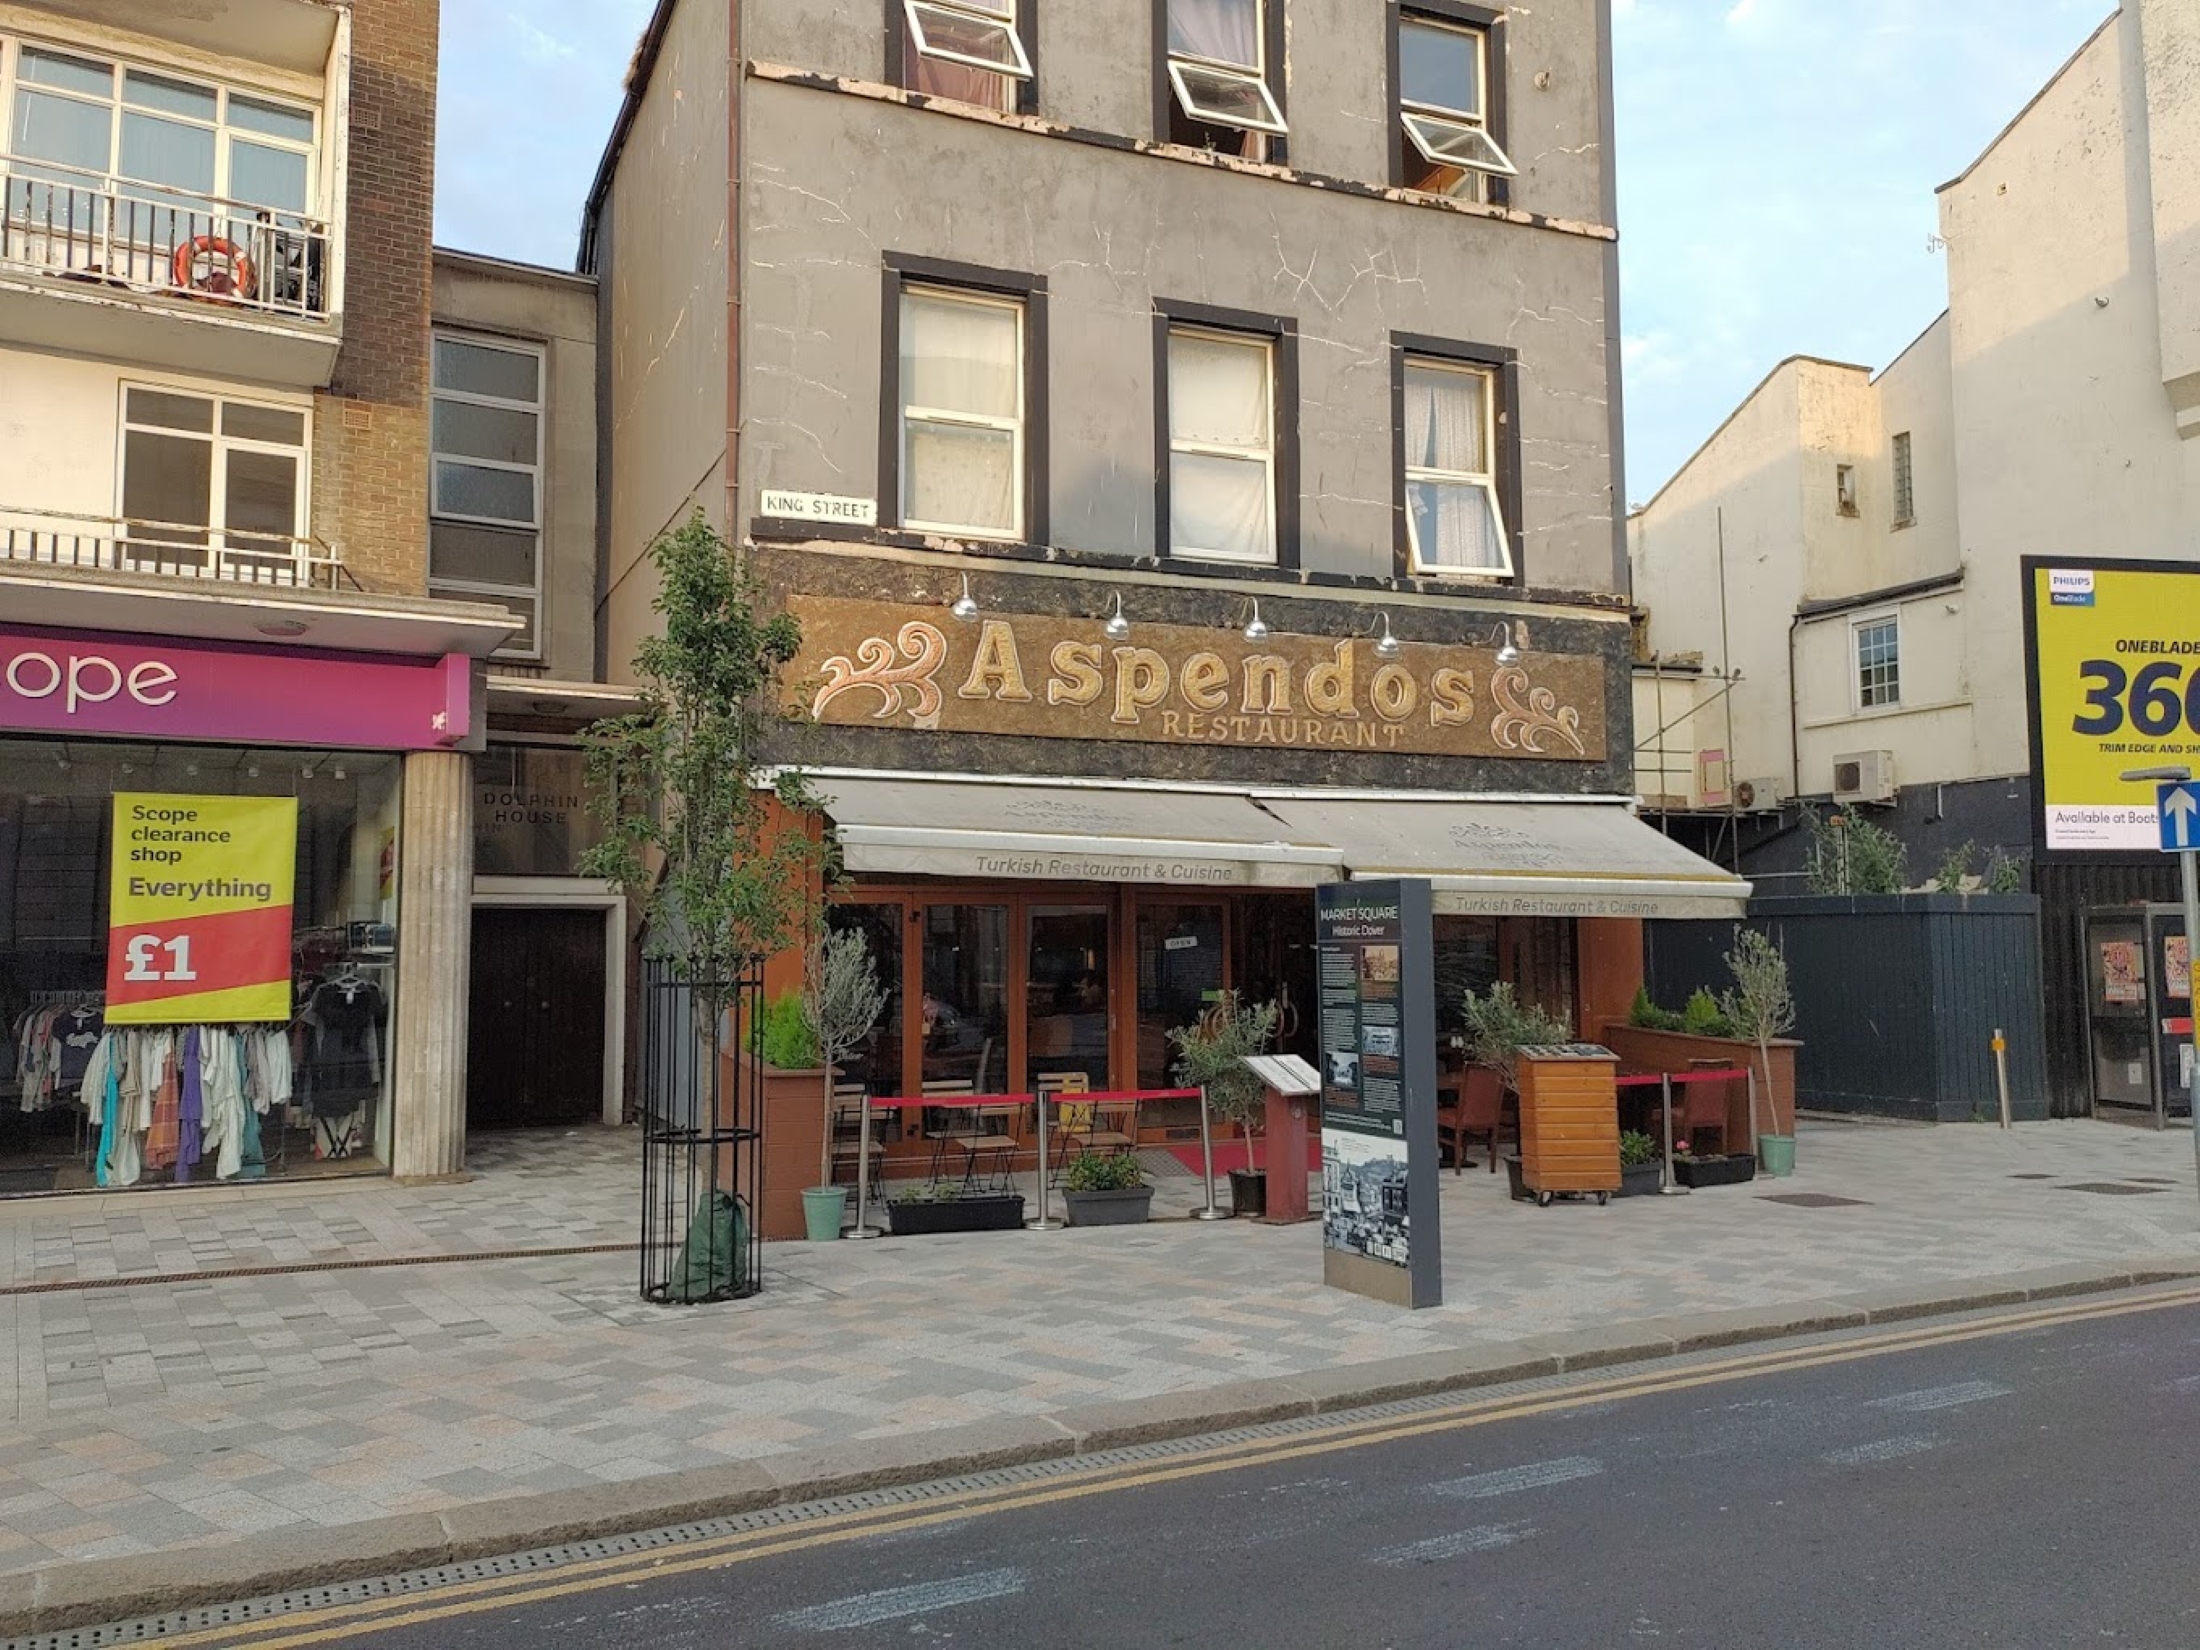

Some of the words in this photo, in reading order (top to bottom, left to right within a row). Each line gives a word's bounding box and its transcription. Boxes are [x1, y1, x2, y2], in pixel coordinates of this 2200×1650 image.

[767, 495, 803, 512] KING
[812, 500, 869, 518] STREET
[2053, 576, 2091, 586] PHILIPS
[2115, 639, 2200, 654] ONEBLADE
[6, 652, 179, 714] ope
[958, 619, 1476, 729] Aspendos
[1161, 709, 1405, 748] RESTAURANT
[2098, 743, 2126, 753] TRIM
[2128, 743, 2157, 753] EDGE
[2158, 744, 2183, 754] AND
[484, 793, 579, 808] DOLPHIN
[132, 804, 199, 825] Scope
[495, 810, 567, 824] HOUSE
[2055, 810, 2110, 824] Available
[2112, 812, 2126, 824] at
[131, 826, 232, 842] clearance
[130, 846, 182, 866] shop
[976, 856, 1044, 875] Turkish
[1050, 858, 1150, 878] Restaurant
[1154, 864, 1167, 879] &
[1171, 864, 1233, 881] Cuisine
[129, 877, 272, 902] Everything
[1320, 908, 1357, 921] MARKET
[1358, 906, 1398, 922] SQUARE
[1455, 896, 1509, 912] Turkish
[1512, 898, 1593, 914] Restaurant
[1598, 900, 1607, 913] &
[1610, 900, 1659, 915] Cuisine
[1332, 925, 1360, 936] Historic
[1361, 924, 1385, 936] Dover
[124, 932, 197, 981] £1
